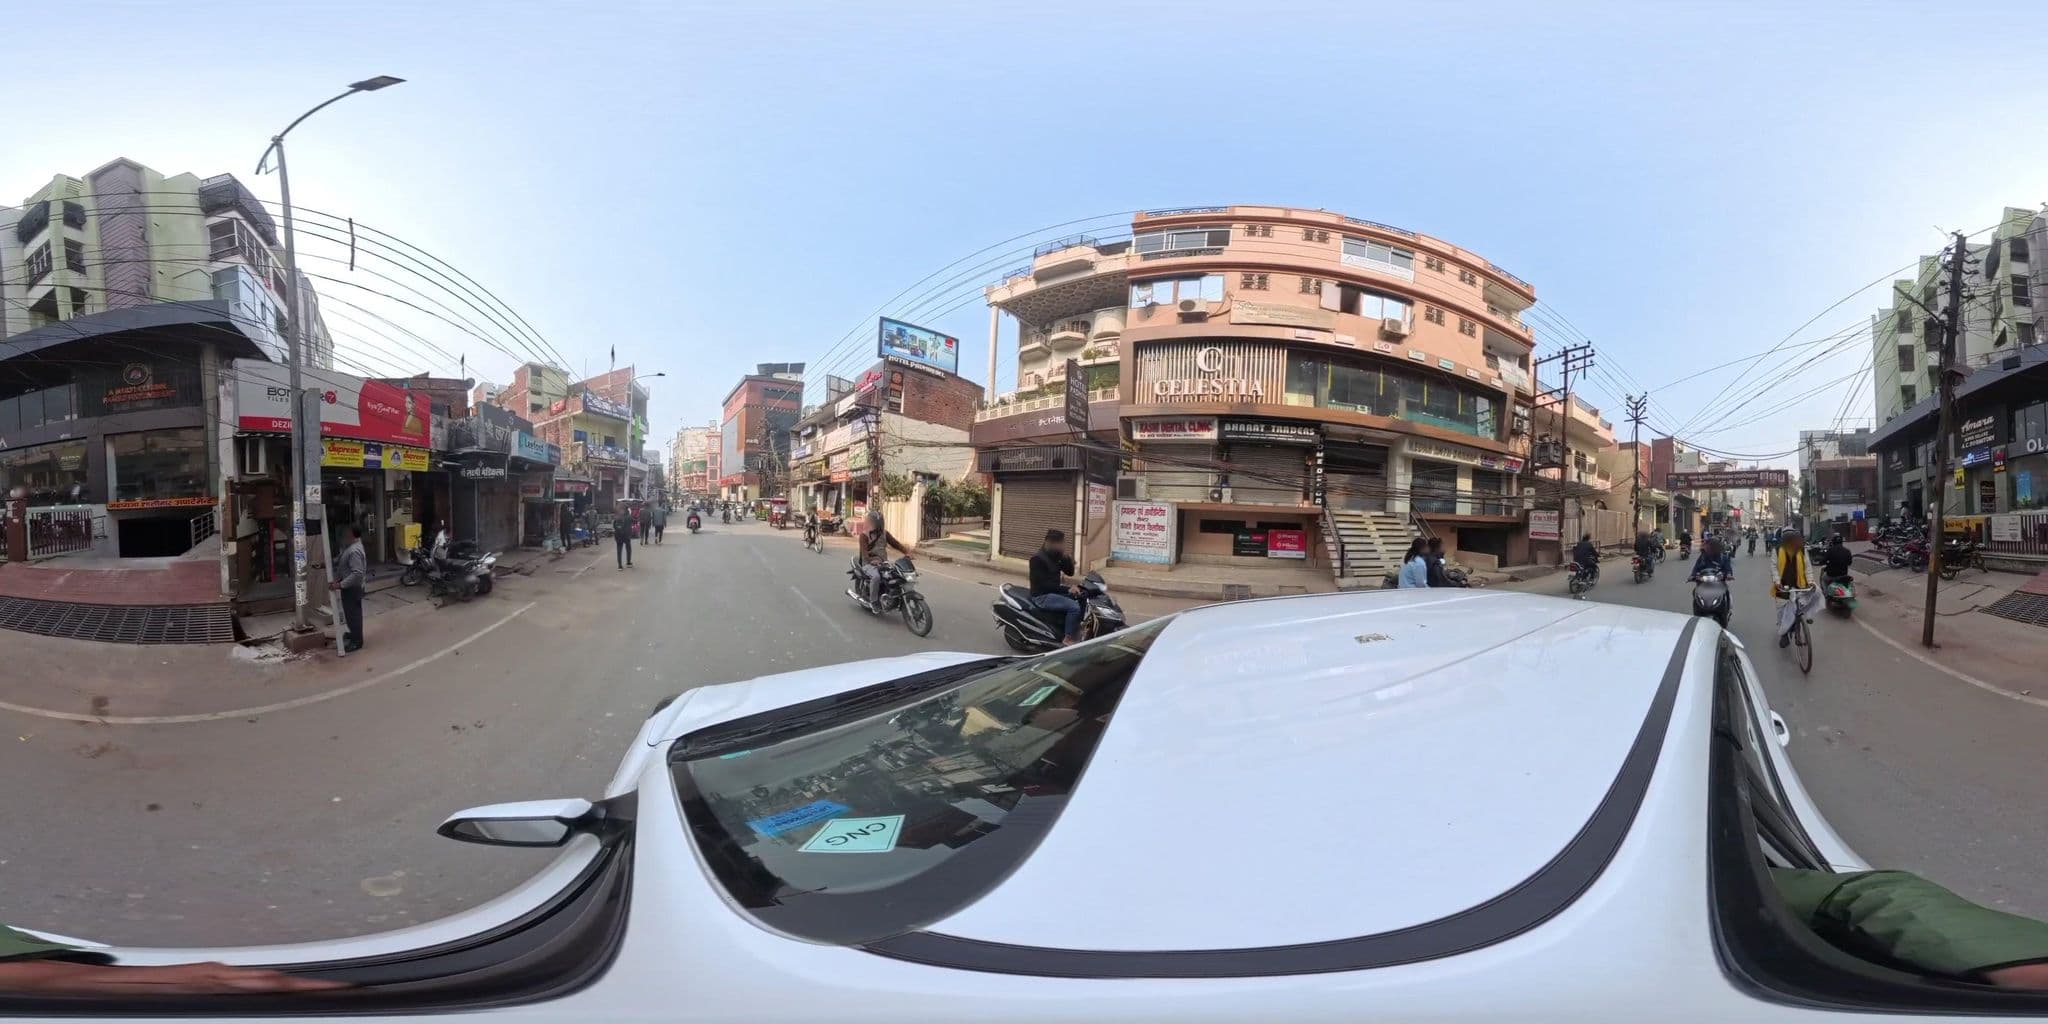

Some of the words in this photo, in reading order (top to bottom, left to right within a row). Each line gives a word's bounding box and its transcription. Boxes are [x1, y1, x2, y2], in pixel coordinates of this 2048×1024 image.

[1155, 378, 1264, 396] CELESTIA
[1161, 422, 1185, 432] DENTAL
[1188, 421, 1214, 432] CLINIC
[1271, 424, 1315, 436] TRADERS
[1961, 416, 1995, 433] Amara
[825, 822, 886, 846] CNG
